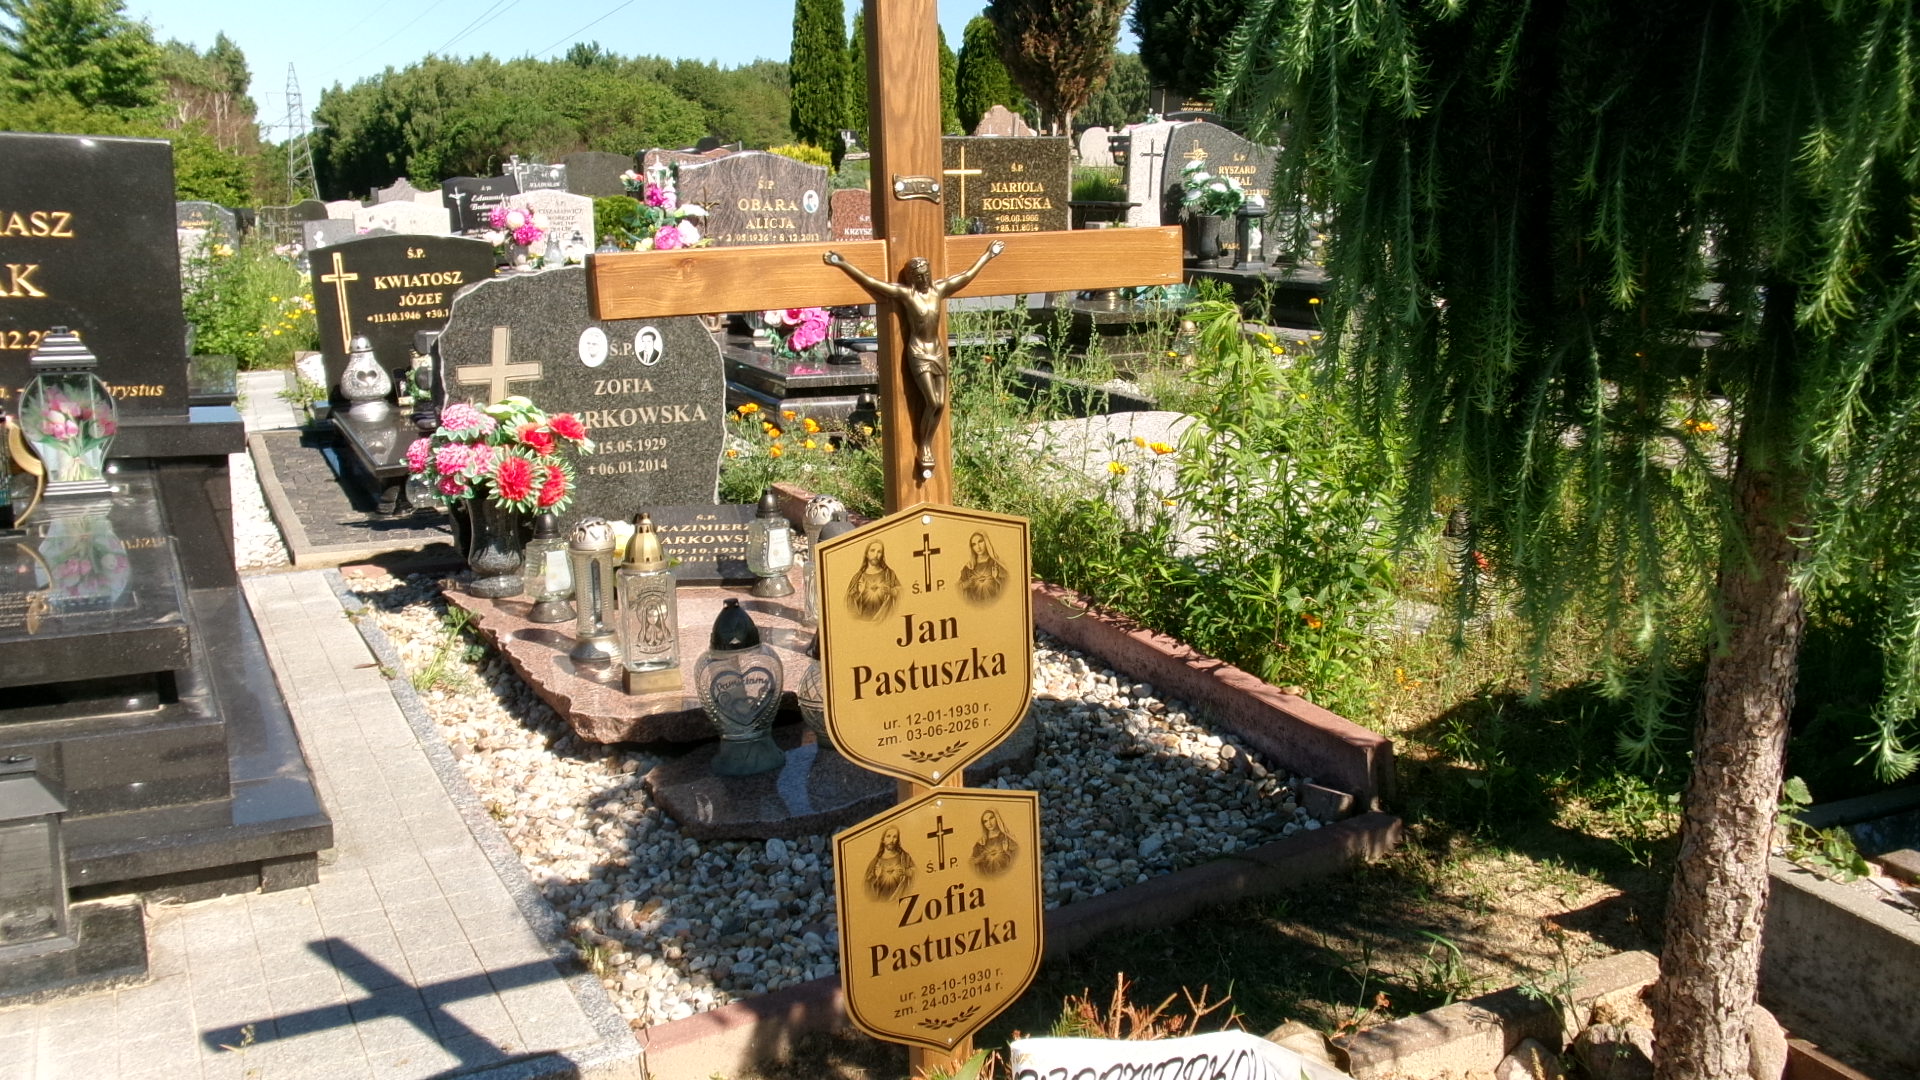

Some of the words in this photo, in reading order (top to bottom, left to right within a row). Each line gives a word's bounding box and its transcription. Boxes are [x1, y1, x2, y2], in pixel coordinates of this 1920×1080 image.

[1218, 165, 1257, 175] RYSZARD
[990, 181, 1044, 193] MARIOLA
[737, 198, 800, 211] OBARA
[981, 194, 1053, 211] KOSIŃSKA
[0, 211, 74, 237] ASZ
[745, 217, 796, 229] ALICJA
[844, 227, 873, 236] KRZYSZ
[373, 270, 464, 290] KWIATOSZ
[398, 291, 443, 307] JÓZEF
[594, 378, 654, 396] ZOFIA
[584, 403, 707, 430] RKOWSKA
[896, 613, 959, 648] Jan
[850, 647, 1008, 702] Pastuszka
[883, 717, 901, 731] ur.
[906, 702, 980, 727] 12-01-1930
[983, 702, 992, 714] r.
[877, 733, 902, 748] zm.
[906, 716, 980, 742] 03-06-2026
[983, 716, 992, 728] r.
[897, 882, 986, 929] Zofia
[868, 917, 1018, 978] Pastuszka
[899, 990, 917, 1003] ur.
[921, 968, 992, 998] 28-10-1930
[995, 966, 1004, 977] r.
[894, 1006, 918, 1019] zm.
[921, 982, 992, 1011] 24-03-2014
[995, 981, 1004, 992] r.
